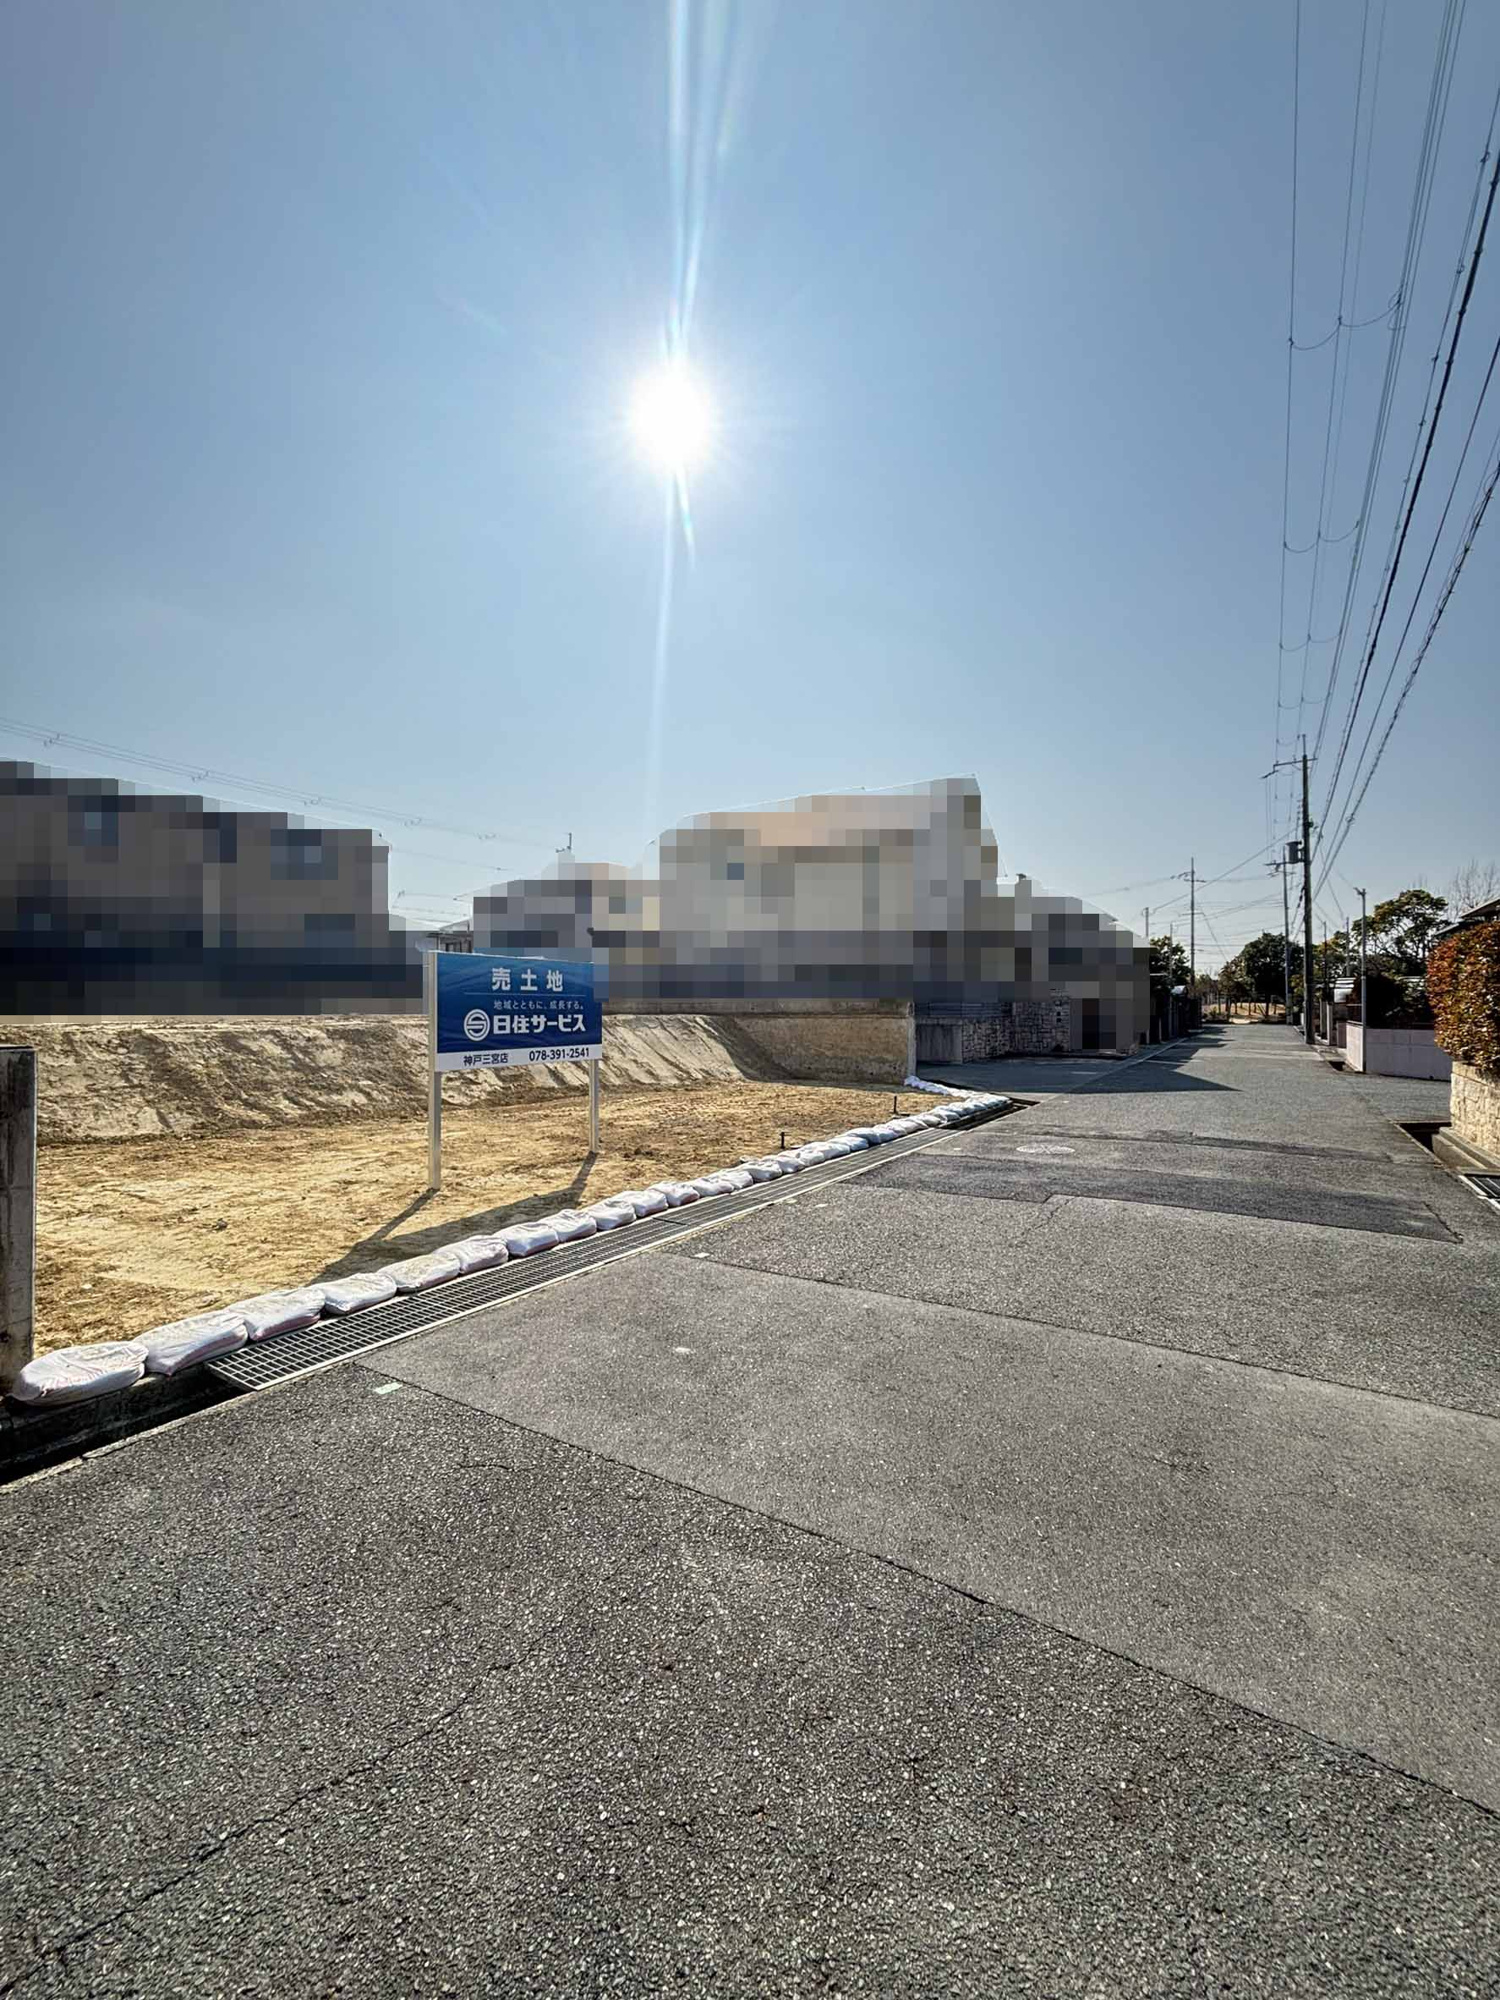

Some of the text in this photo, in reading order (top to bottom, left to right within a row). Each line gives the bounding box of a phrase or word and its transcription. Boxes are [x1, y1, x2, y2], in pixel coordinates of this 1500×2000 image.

[493, 999, 584, 1010] 地域とともに、成長する。
[493, 1014, 586, 1035] 日住サービス
[463, 1052, 509, 1067] 神戸三宮店
[529, 1047, 589, 1062] 078-391-2541
